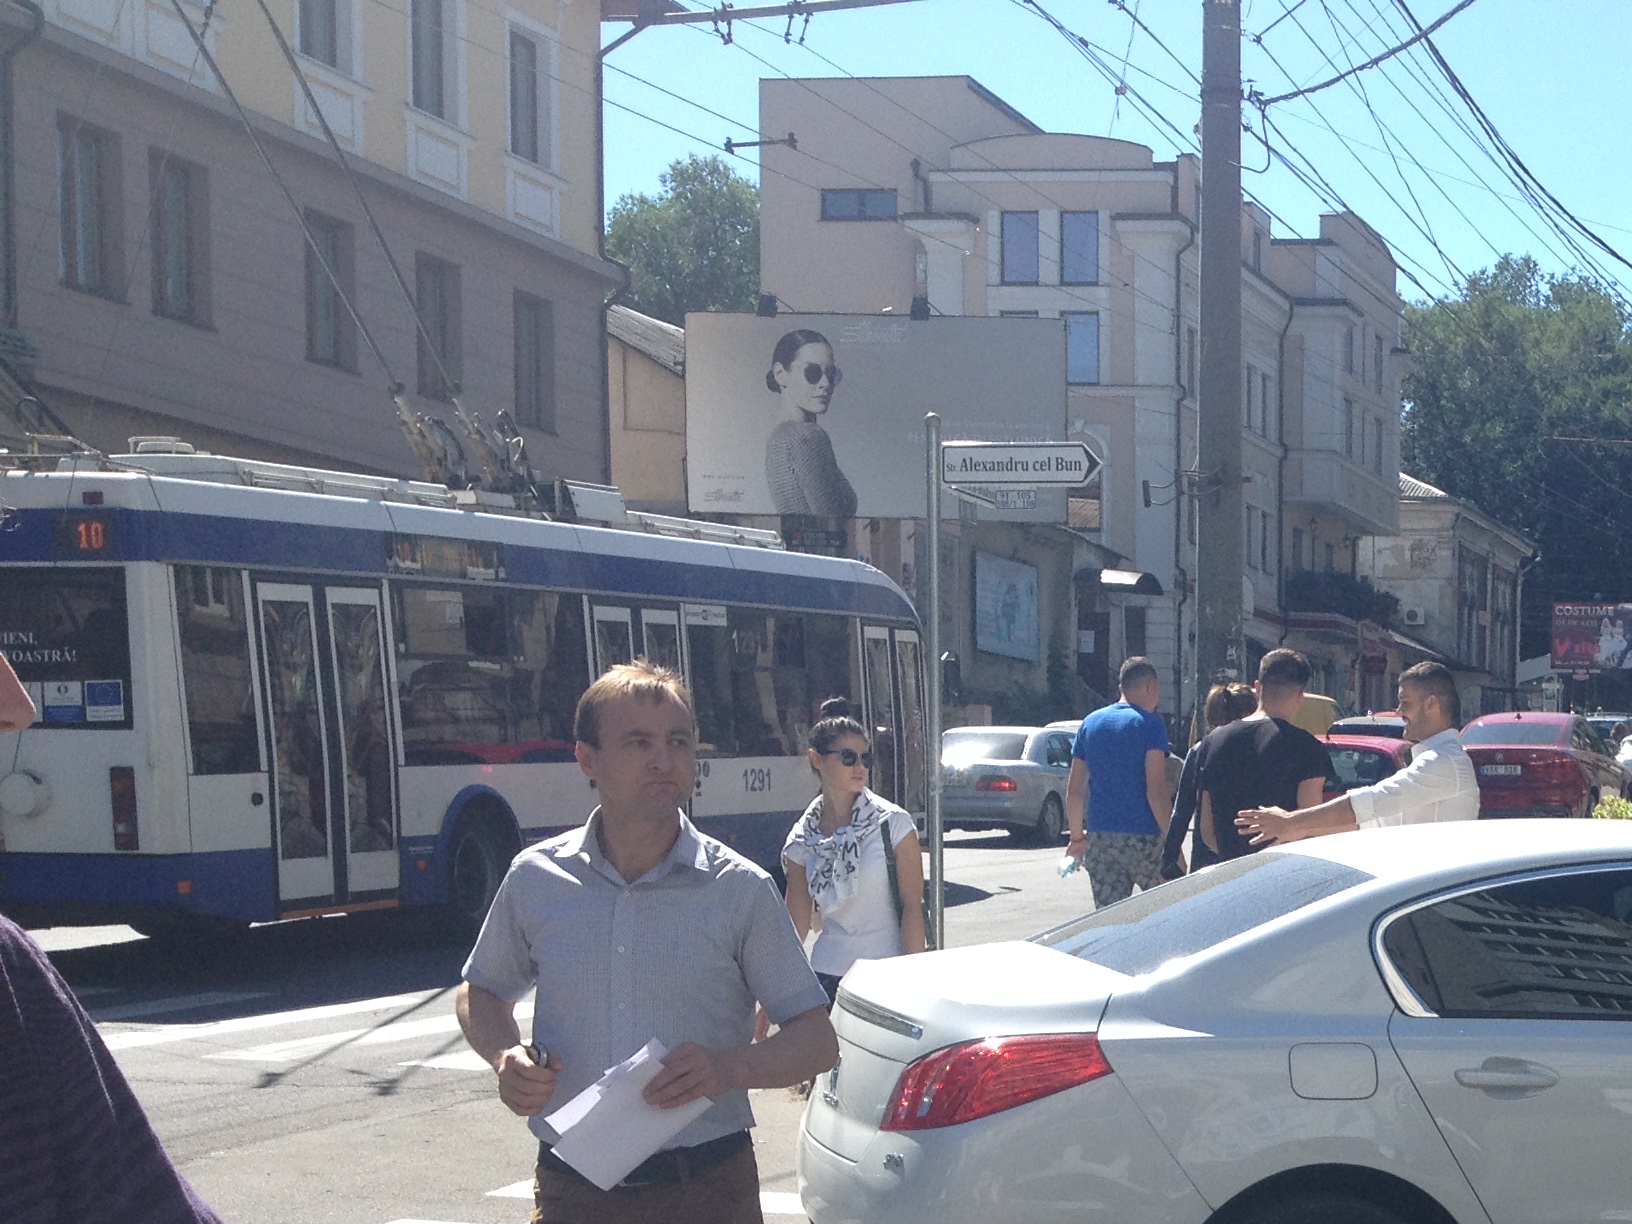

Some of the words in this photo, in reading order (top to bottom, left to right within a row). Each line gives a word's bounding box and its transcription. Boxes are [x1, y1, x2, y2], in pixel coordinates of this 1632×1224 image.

[960, 457, 1029, 472] Alexandru
[1033, 456, 1051, 472] cel
[1055, 457, 1083, 472] Bun
[77, 521, 104, 549] 10
[1554, 605, 1615, 617] COSTUME
[743, 768, 771, 791] 1291
